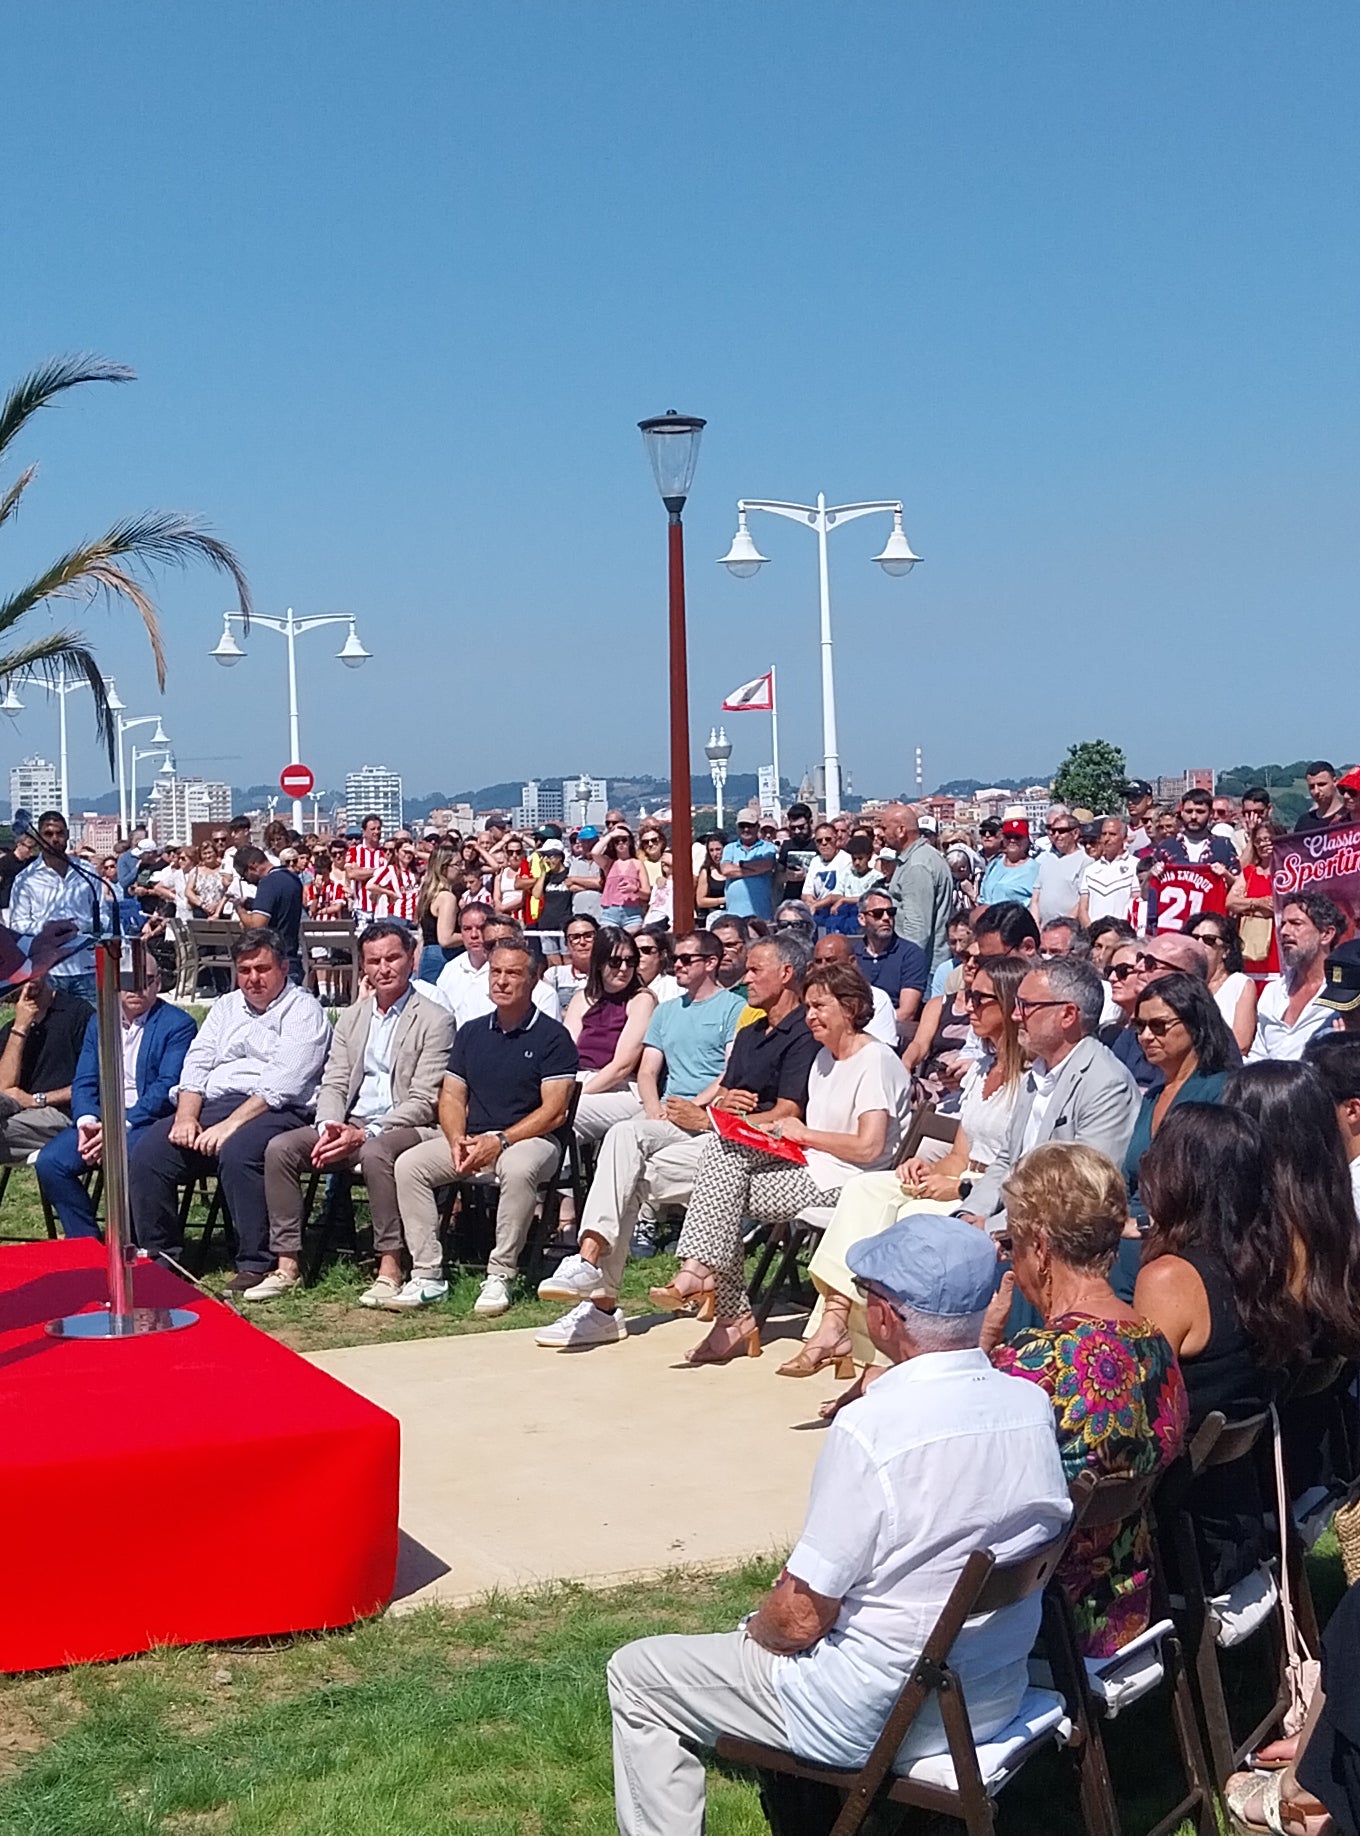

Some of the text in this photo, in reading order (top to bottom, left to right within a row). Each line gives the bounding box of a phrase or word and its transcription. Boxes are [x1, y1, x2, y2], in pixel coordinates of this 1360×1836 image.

[1303, 830, 1360, 857] Classic
[1177, 870, 1214, 893] ENRIQUE
[1157, 886, 1204, 930] 21
